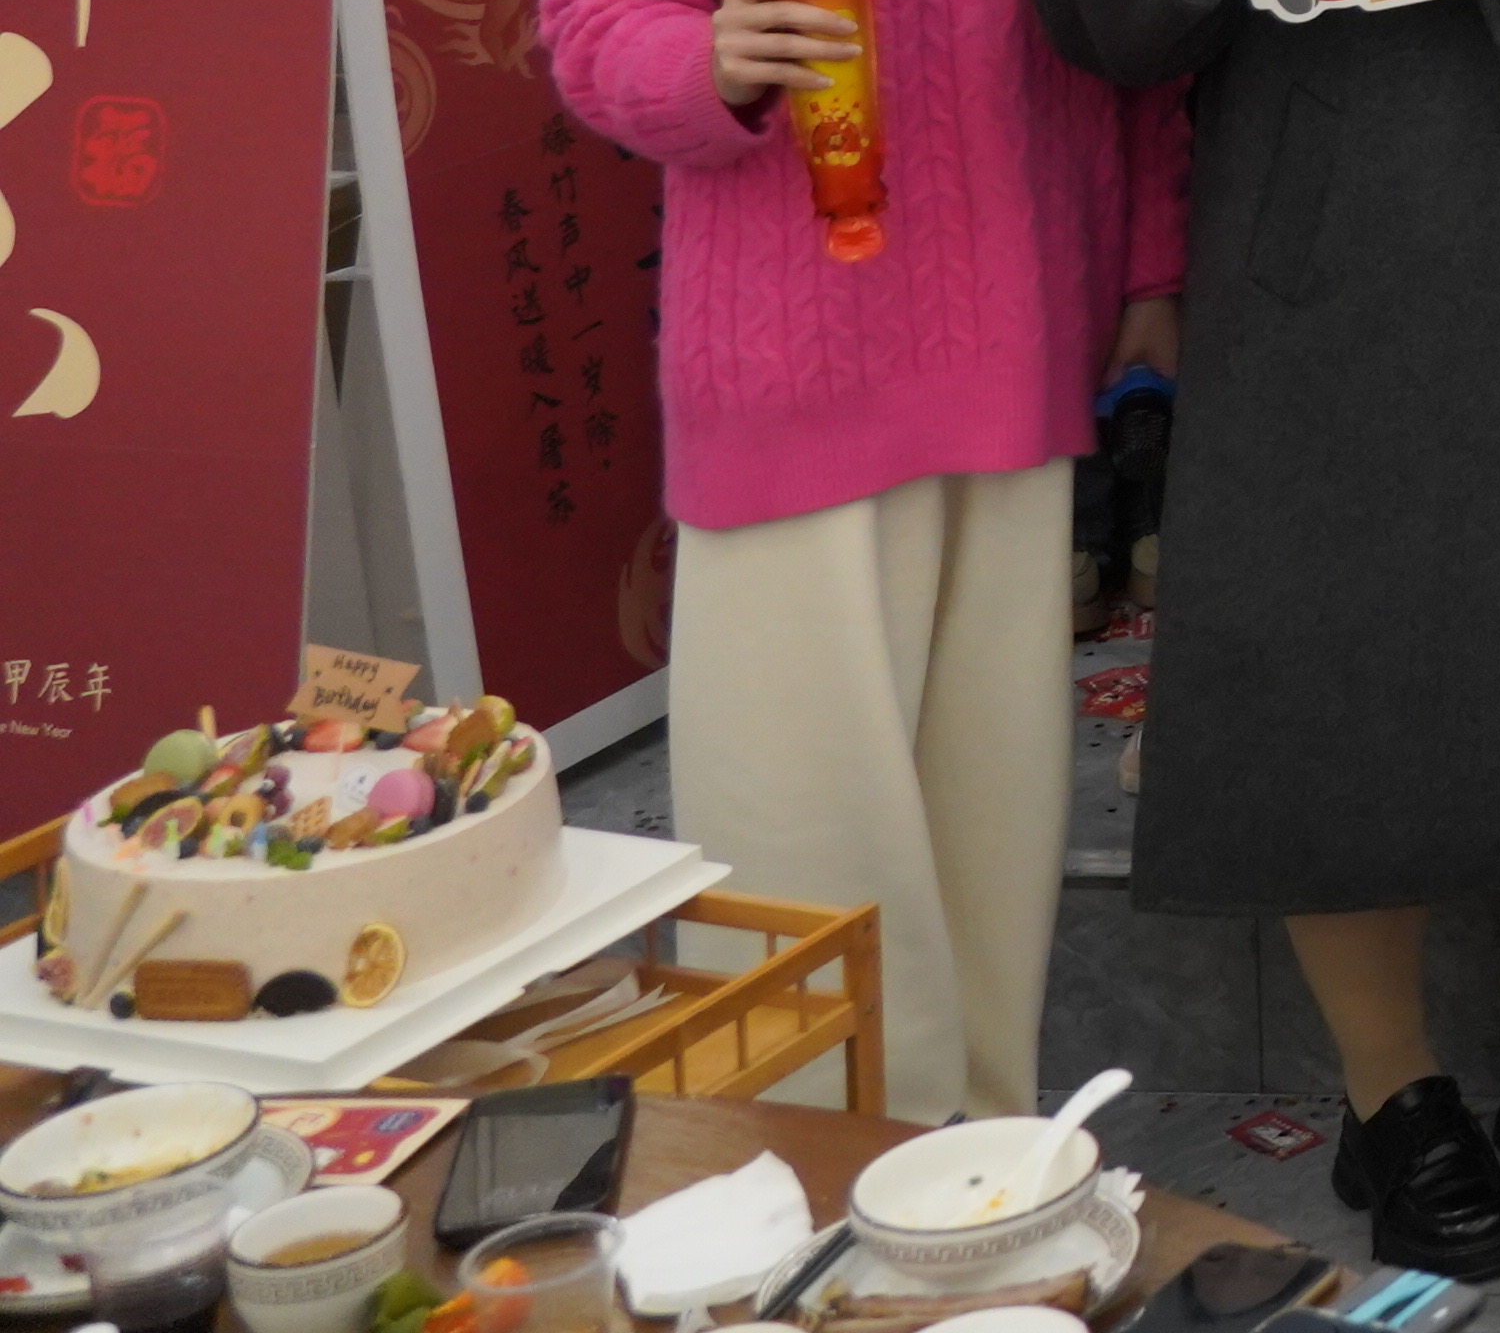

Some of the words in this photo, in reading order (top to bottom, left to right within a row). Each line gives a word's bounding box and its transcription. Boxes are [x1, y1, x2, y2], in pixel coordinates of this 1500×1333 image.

[4, 659, 113, 713] 甲辰年
[332, 654, 381, 684] Happy
[312, 685, 381, 722] Birthday
